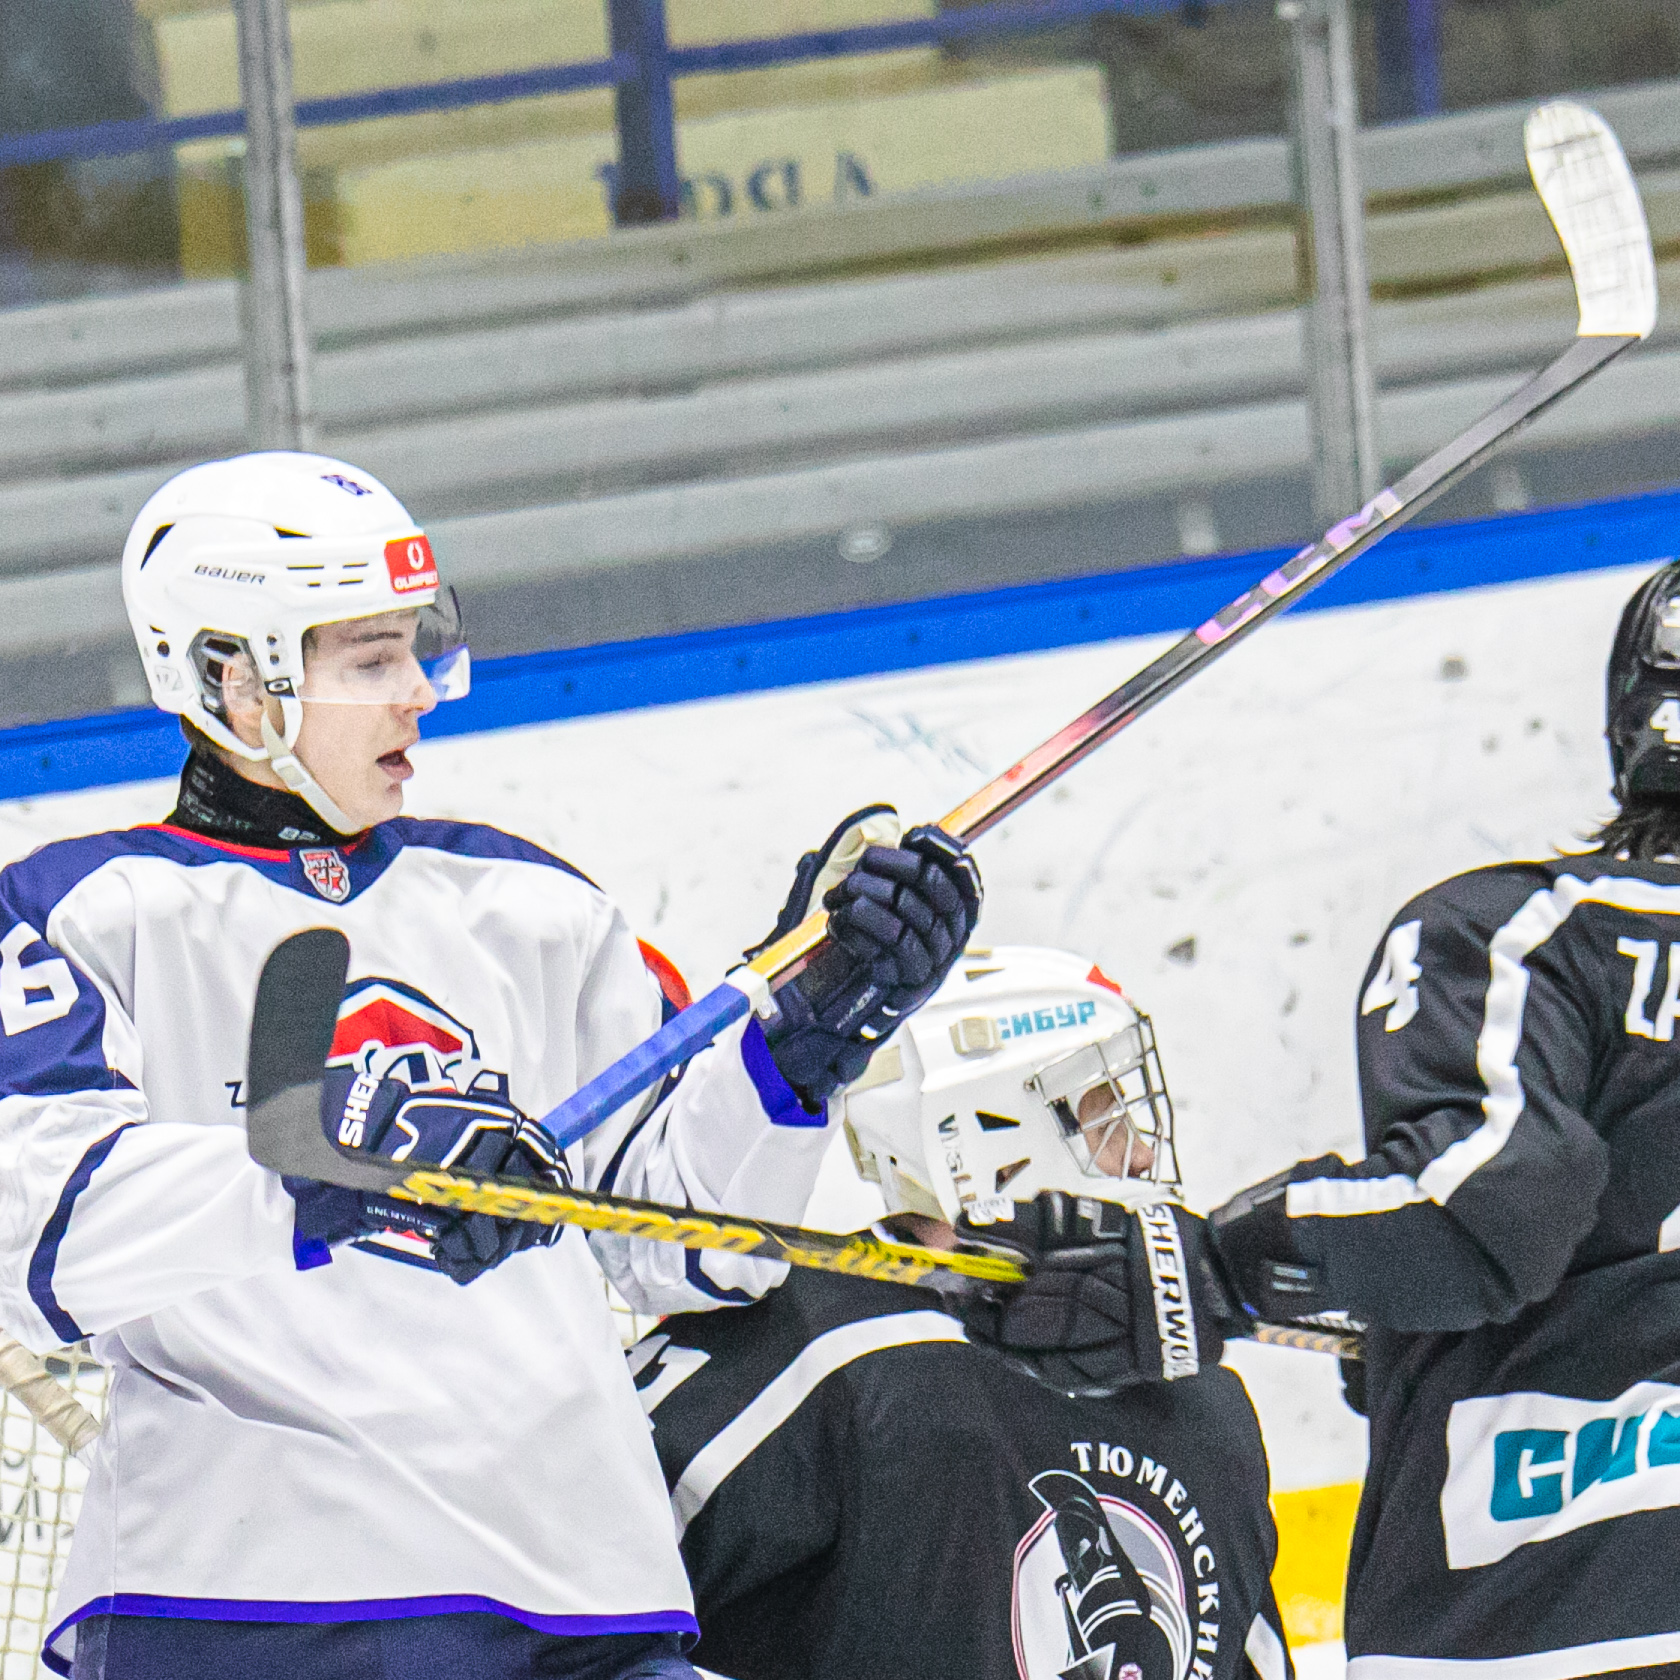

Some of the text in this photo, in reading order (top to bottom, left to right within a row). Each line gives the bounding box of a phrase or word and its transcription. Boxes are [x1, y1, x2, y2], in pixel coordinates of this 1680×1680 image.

[193, 562, 267, 587] BAUER
[1196, 488, 1403, 647] CCM
[1360, 919, 1422, 1033] 4
